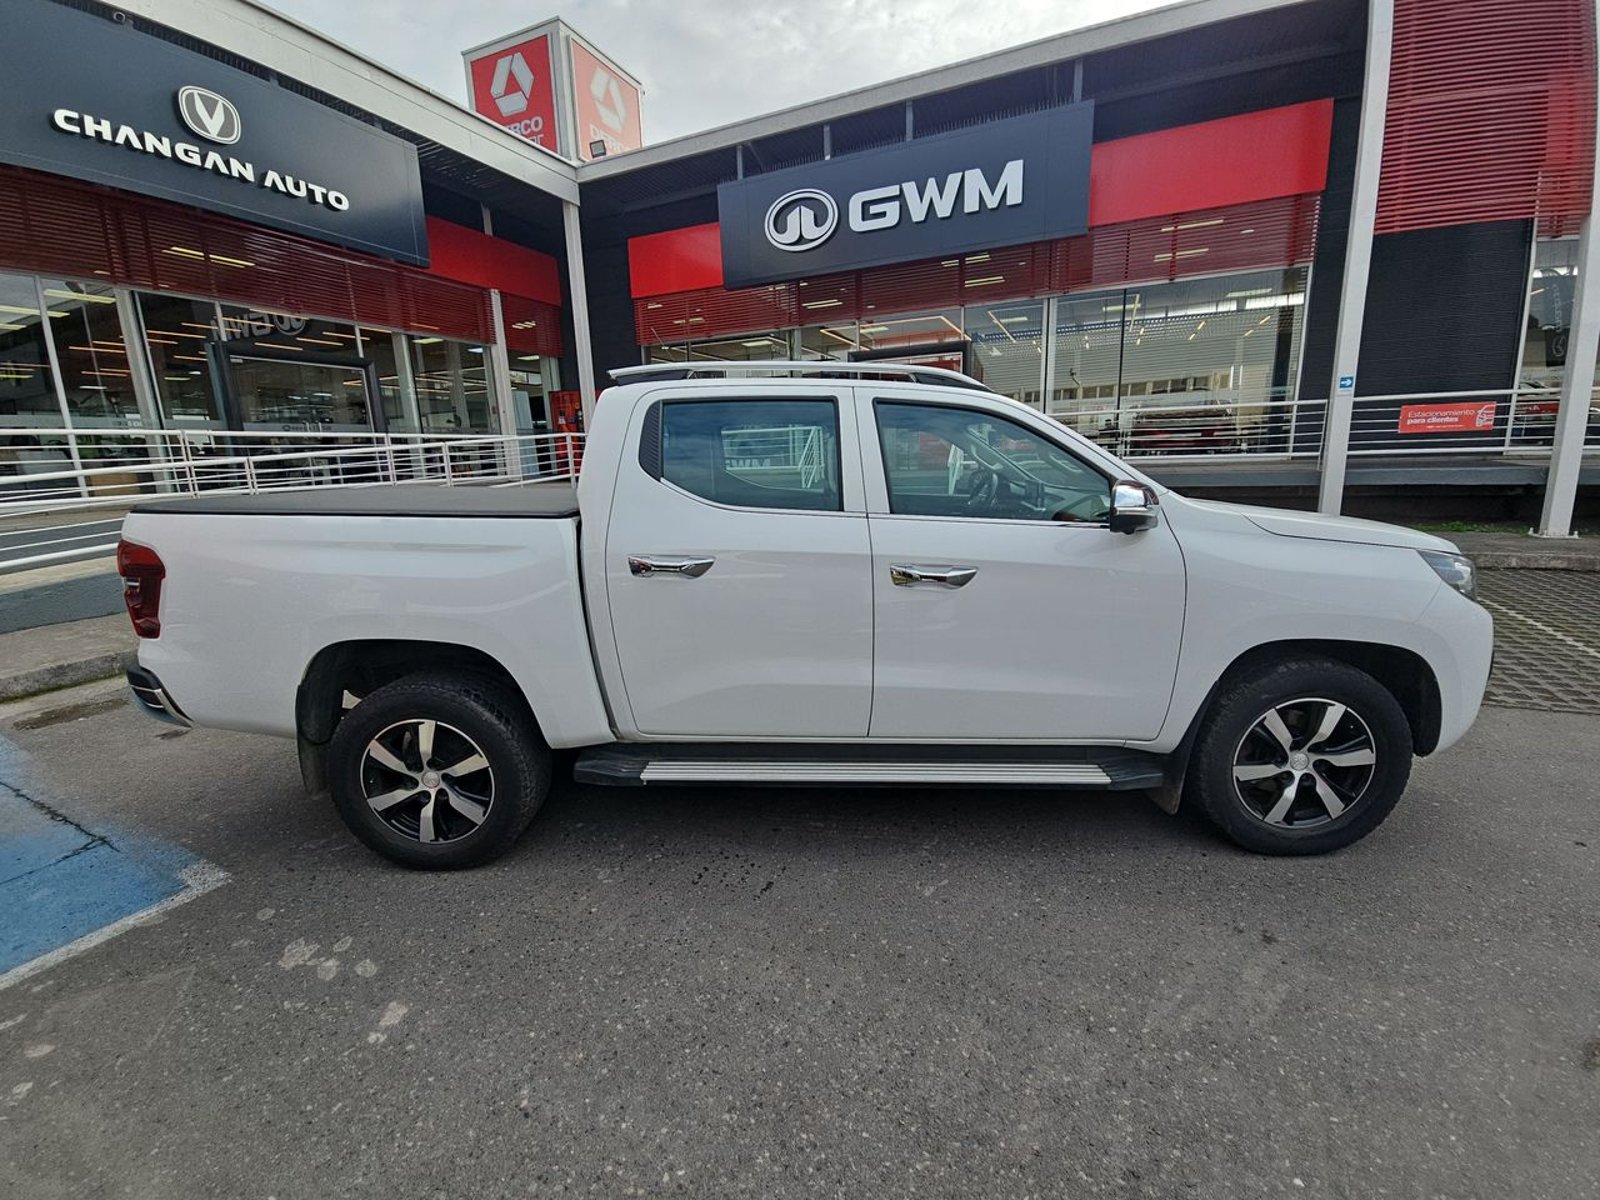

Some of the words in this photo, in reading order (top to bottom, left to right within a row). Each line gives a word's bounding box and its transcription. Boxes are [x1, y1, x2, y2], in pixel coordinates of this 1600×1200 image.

[54, 109, 255, 182] CHANGAN
[264, 170, 350, 211] AUTO
[849, 159, 1024, 232] GWM
[1408, 409, 1475, 418] Estacionamiento
[1427, 416, 1459, 424] clientes
